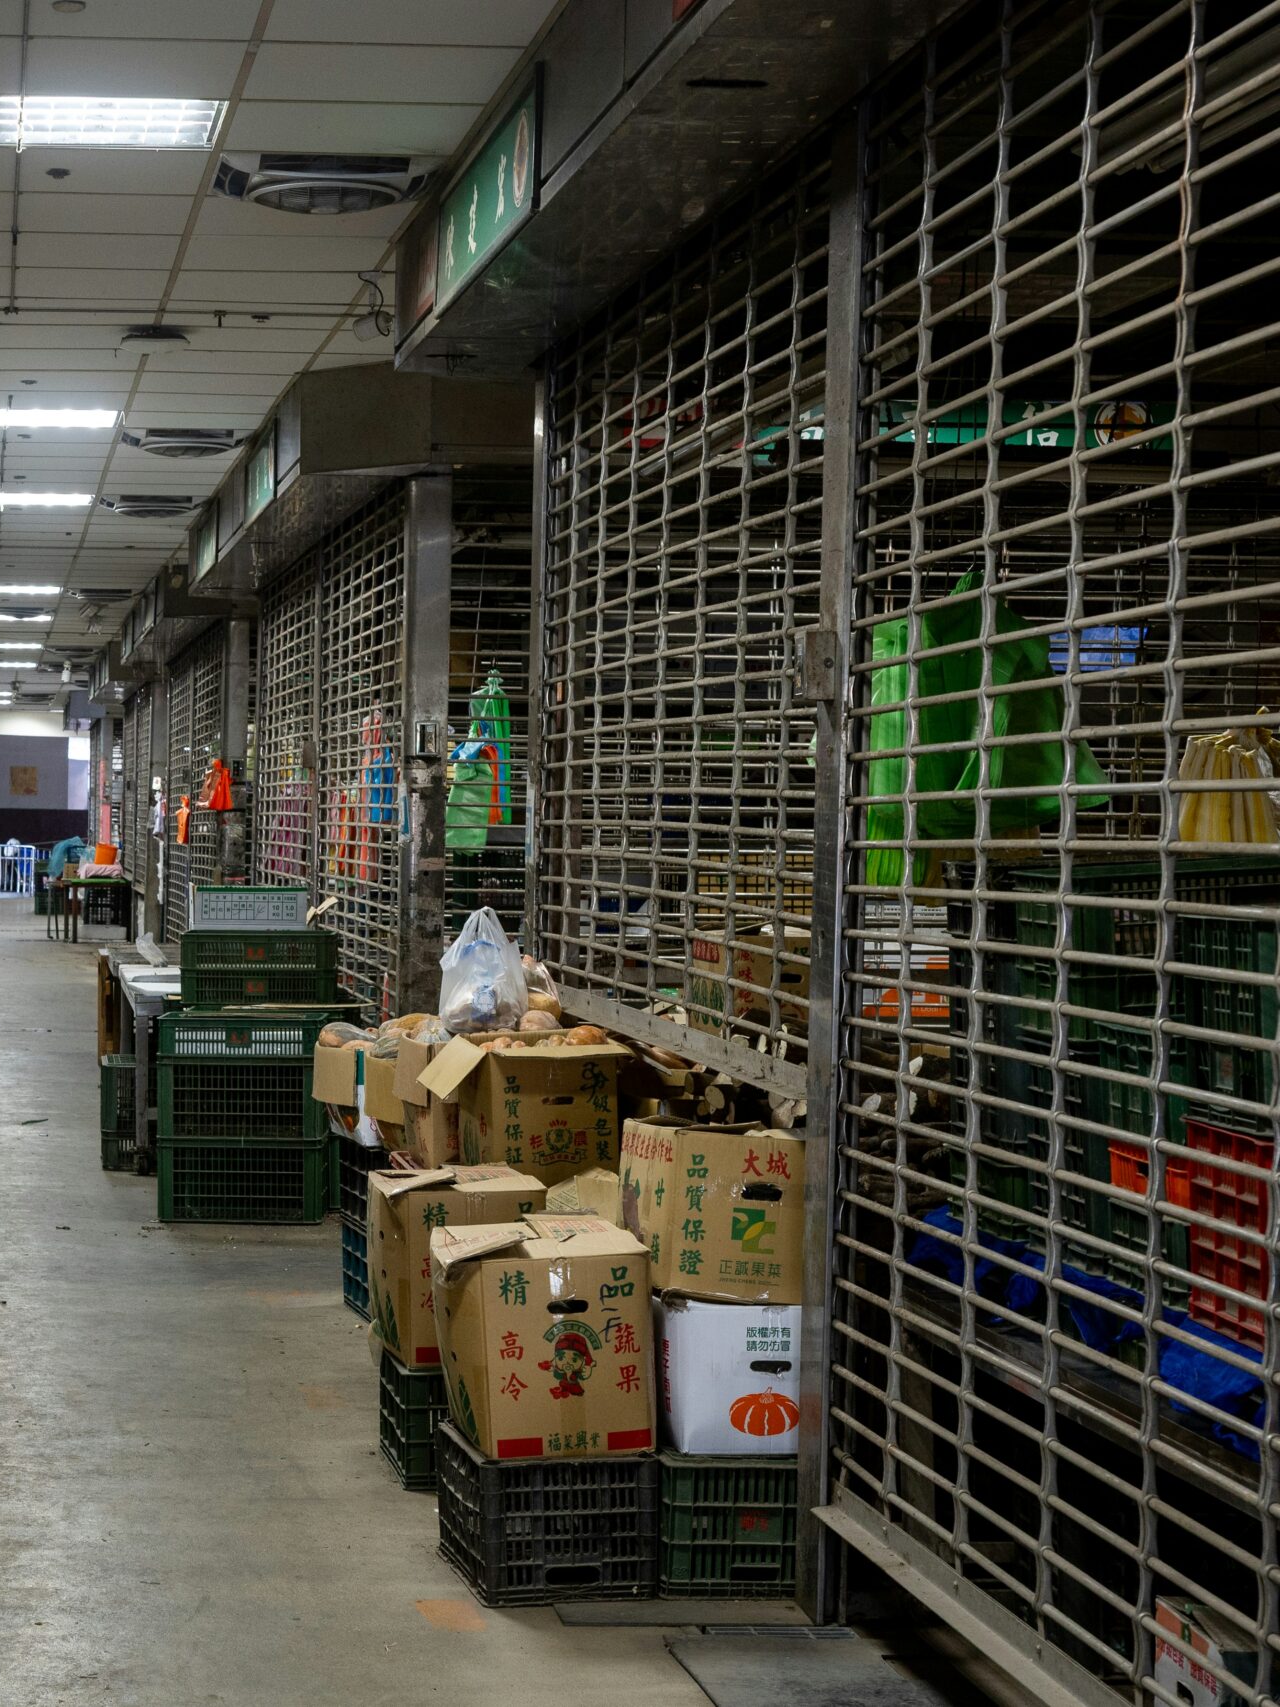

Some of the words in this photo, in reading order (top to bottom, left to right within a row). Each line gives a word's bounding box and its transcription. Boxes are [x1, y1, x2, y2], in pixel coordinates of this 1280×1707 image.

[503, 1075, 524, 1165] 品質保証
[741, 1148, 792, 1181] 大城
[679, 1153, 709, 1276] 品質保證
[719, 1258, 784, 1279] 正誠果菜
[498, 1270, 531, 1306] 精
[746, 1326, 792, 1339] 版權所有
[746, 1340, 792, 1352] 請勿仿冒
[499, 1330, 529, 1402] 高冷
[613, 1322, 641, 1394] 蔬果
